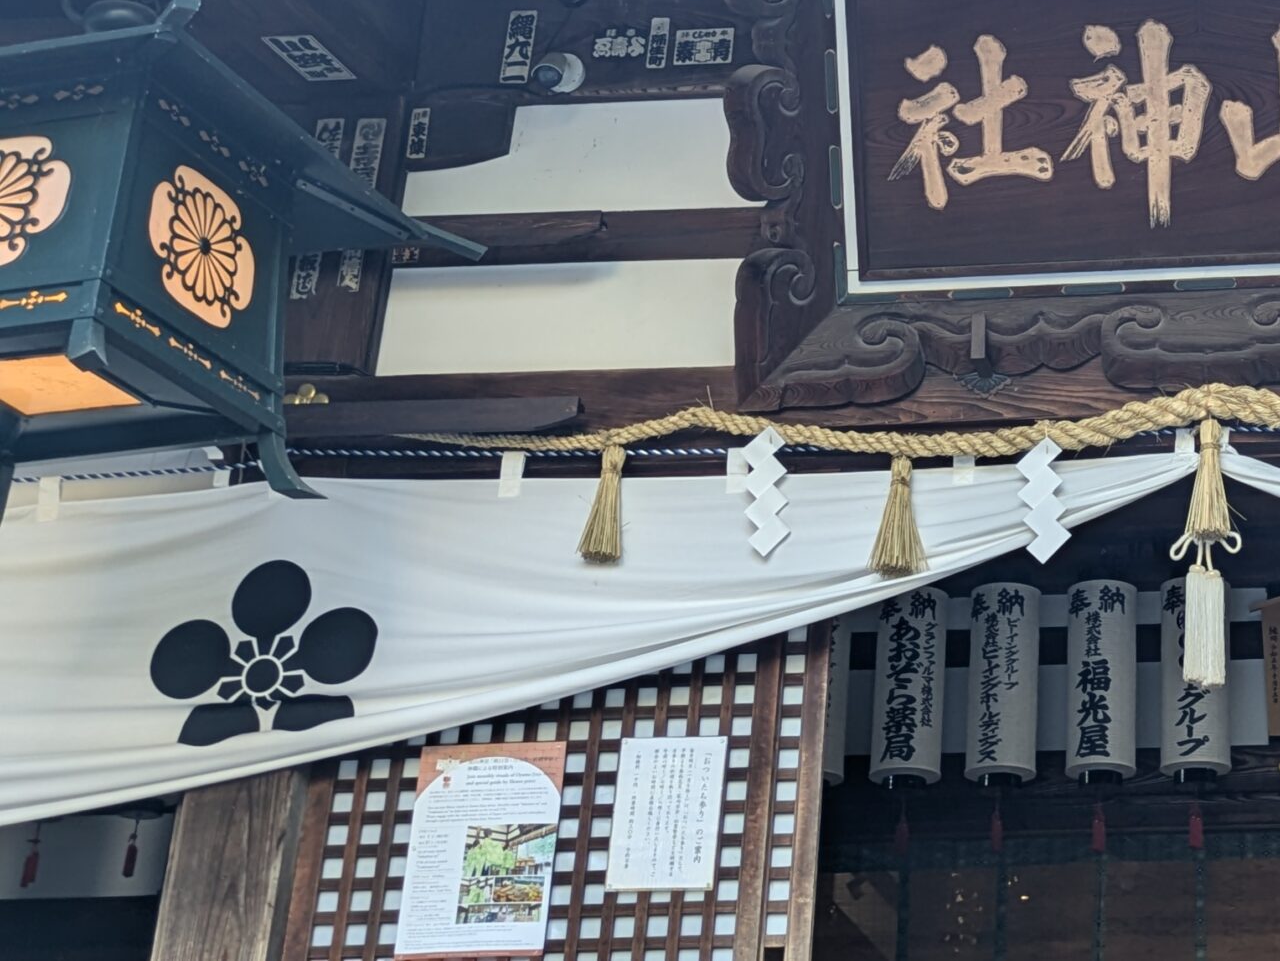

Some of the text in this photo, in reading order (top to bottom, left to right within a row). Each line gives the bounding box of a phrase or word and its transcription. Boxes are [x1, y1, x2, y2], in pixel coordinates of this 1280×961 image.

[971, 587, 1025, 621] 奉納
[1069, 585, 1126, 618] 奉納
[1084, 610, 1103, 658] 株式会社
[880, 616, 923, 763] あおぞら薬局
[1075, 658, 1112, 758] 福光屋
